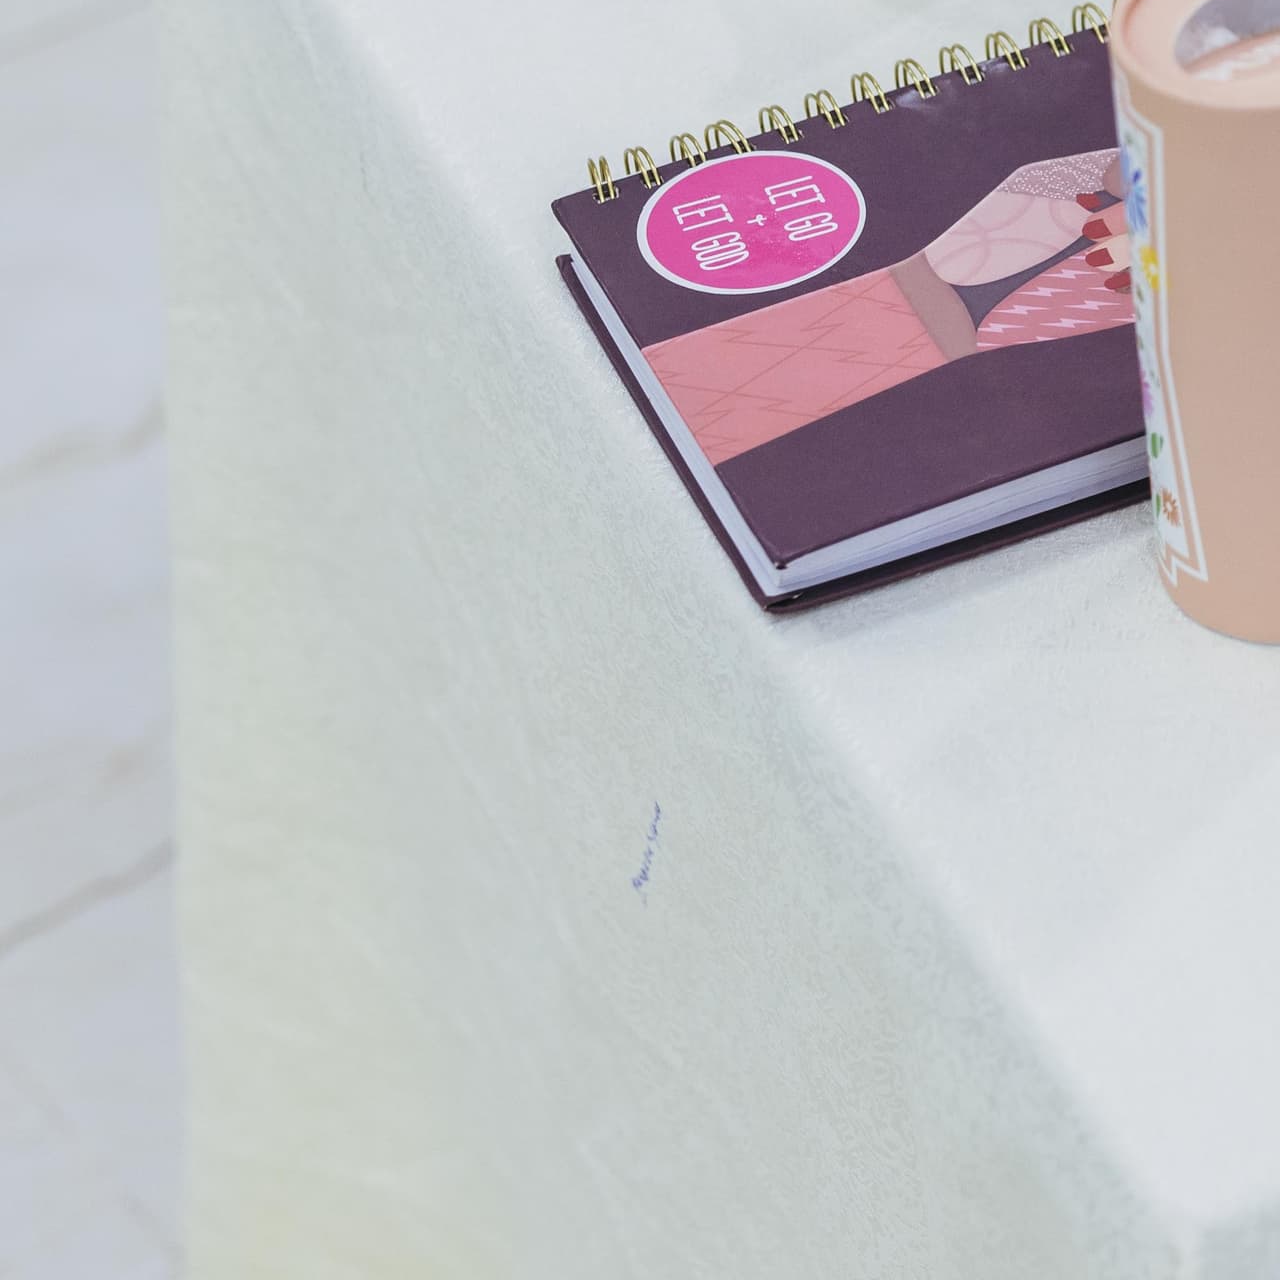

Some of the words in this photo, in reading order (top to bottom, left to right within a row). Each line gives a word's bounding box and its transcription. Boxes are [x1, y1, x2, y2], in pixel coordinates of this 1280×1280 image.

[671, 194, 735, 232] LET
[763, 175, 827, 213] LET
[783, 211, 839, 242] GO
[690, 230, 750, 272] GOD
